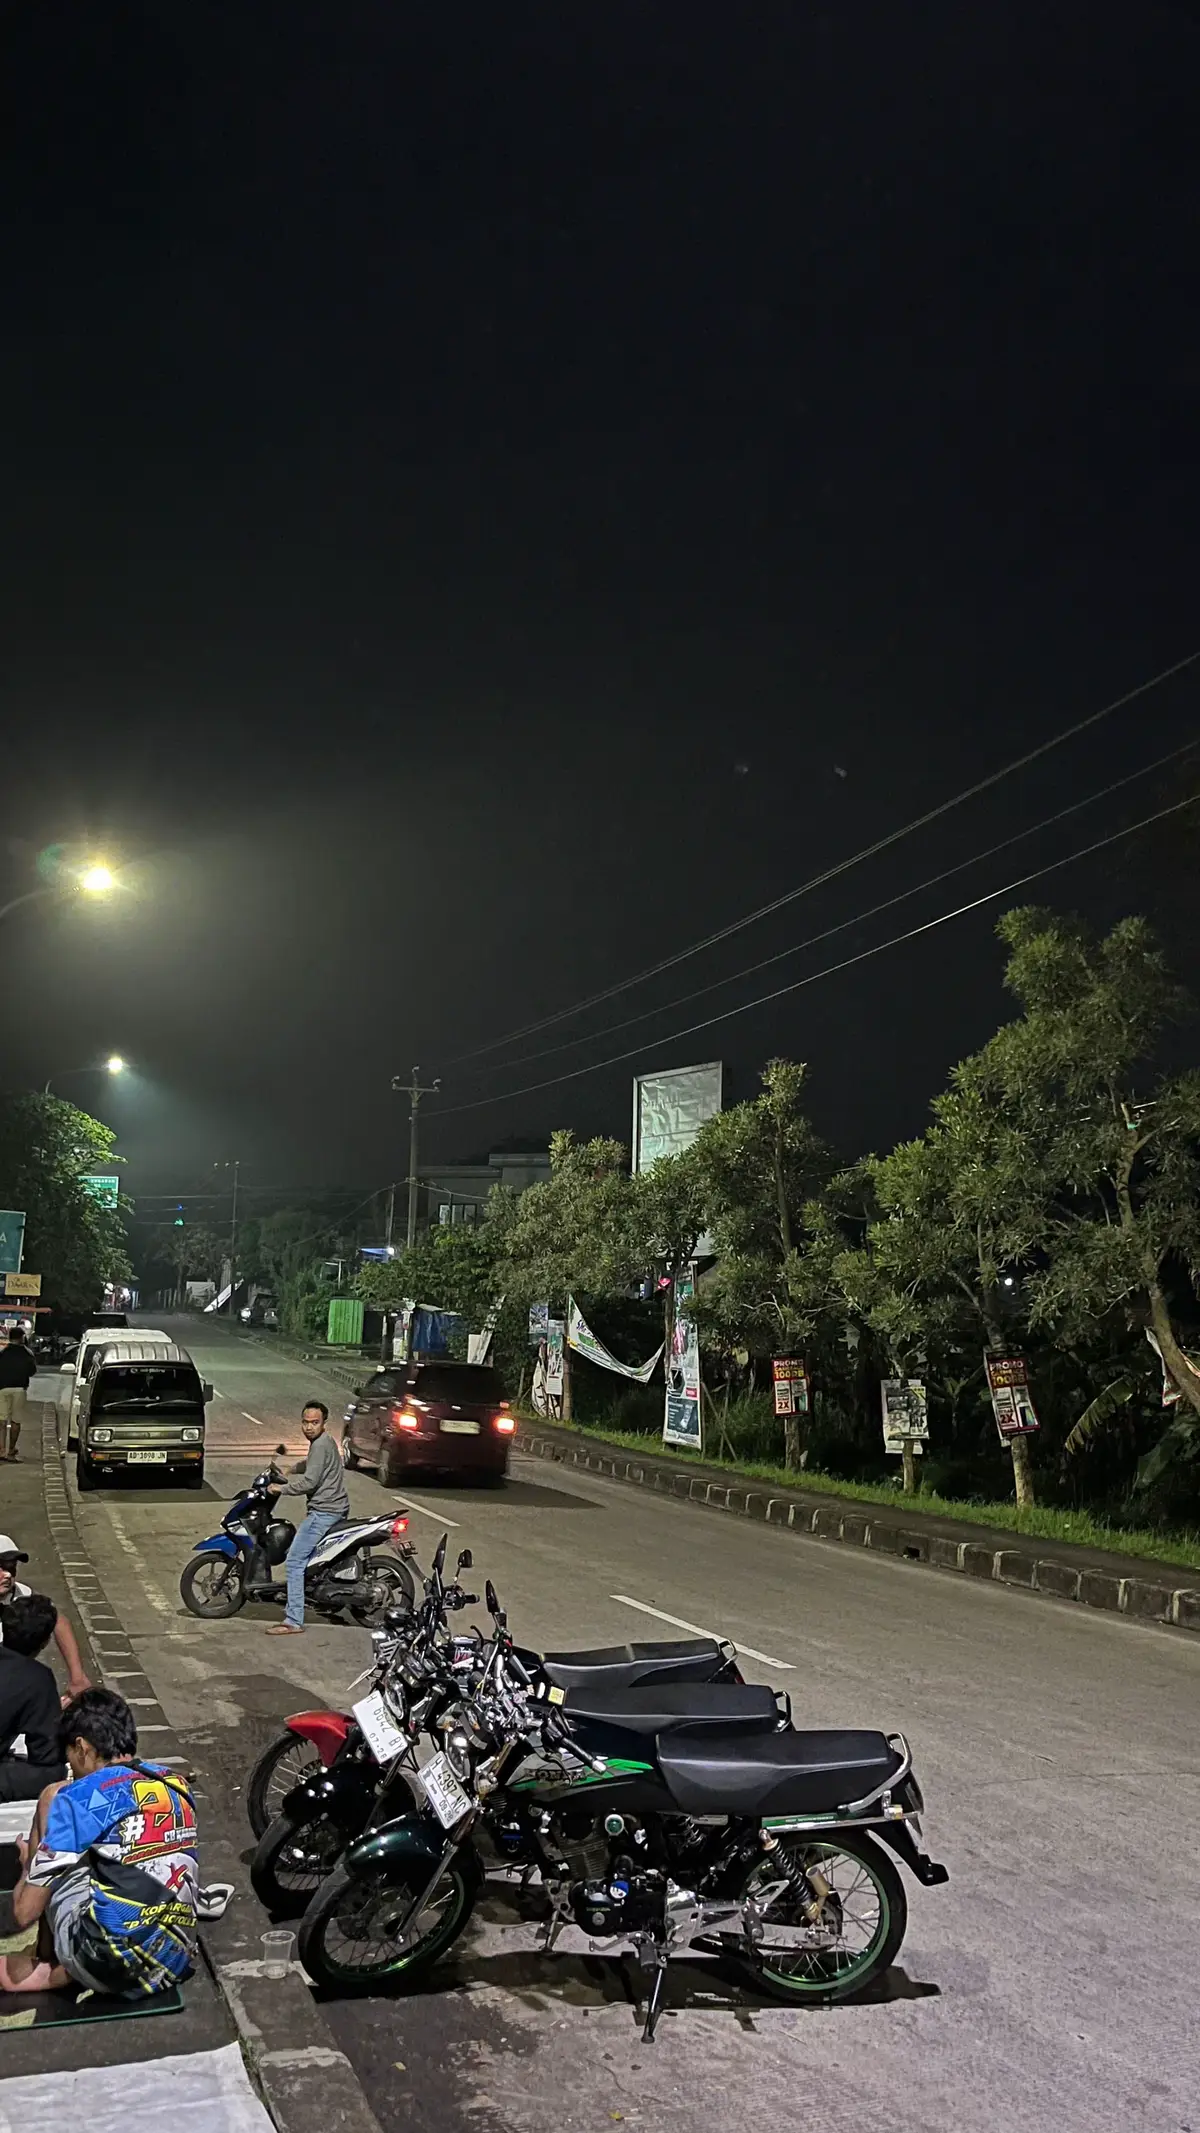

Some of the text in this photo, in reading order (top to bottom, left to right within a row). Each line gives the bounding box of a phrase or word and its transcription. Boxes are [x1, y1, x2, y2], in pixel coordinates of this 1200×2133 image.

[773, 1360, 804, 1368] PROMO
[990, 1361, 1022, 1371] PROMO
[778, 1401, 790, 1409] 2X
[1000, 1413, 1015, 1424] 2X
[366, 1695, 378, 1704] H
[388, 1736, 405, 1751] BY
[432, 1757, 443, 1770] H
[437, 1770, 458, 1795] 4397
[451, 1795, 467, 1814] NC
